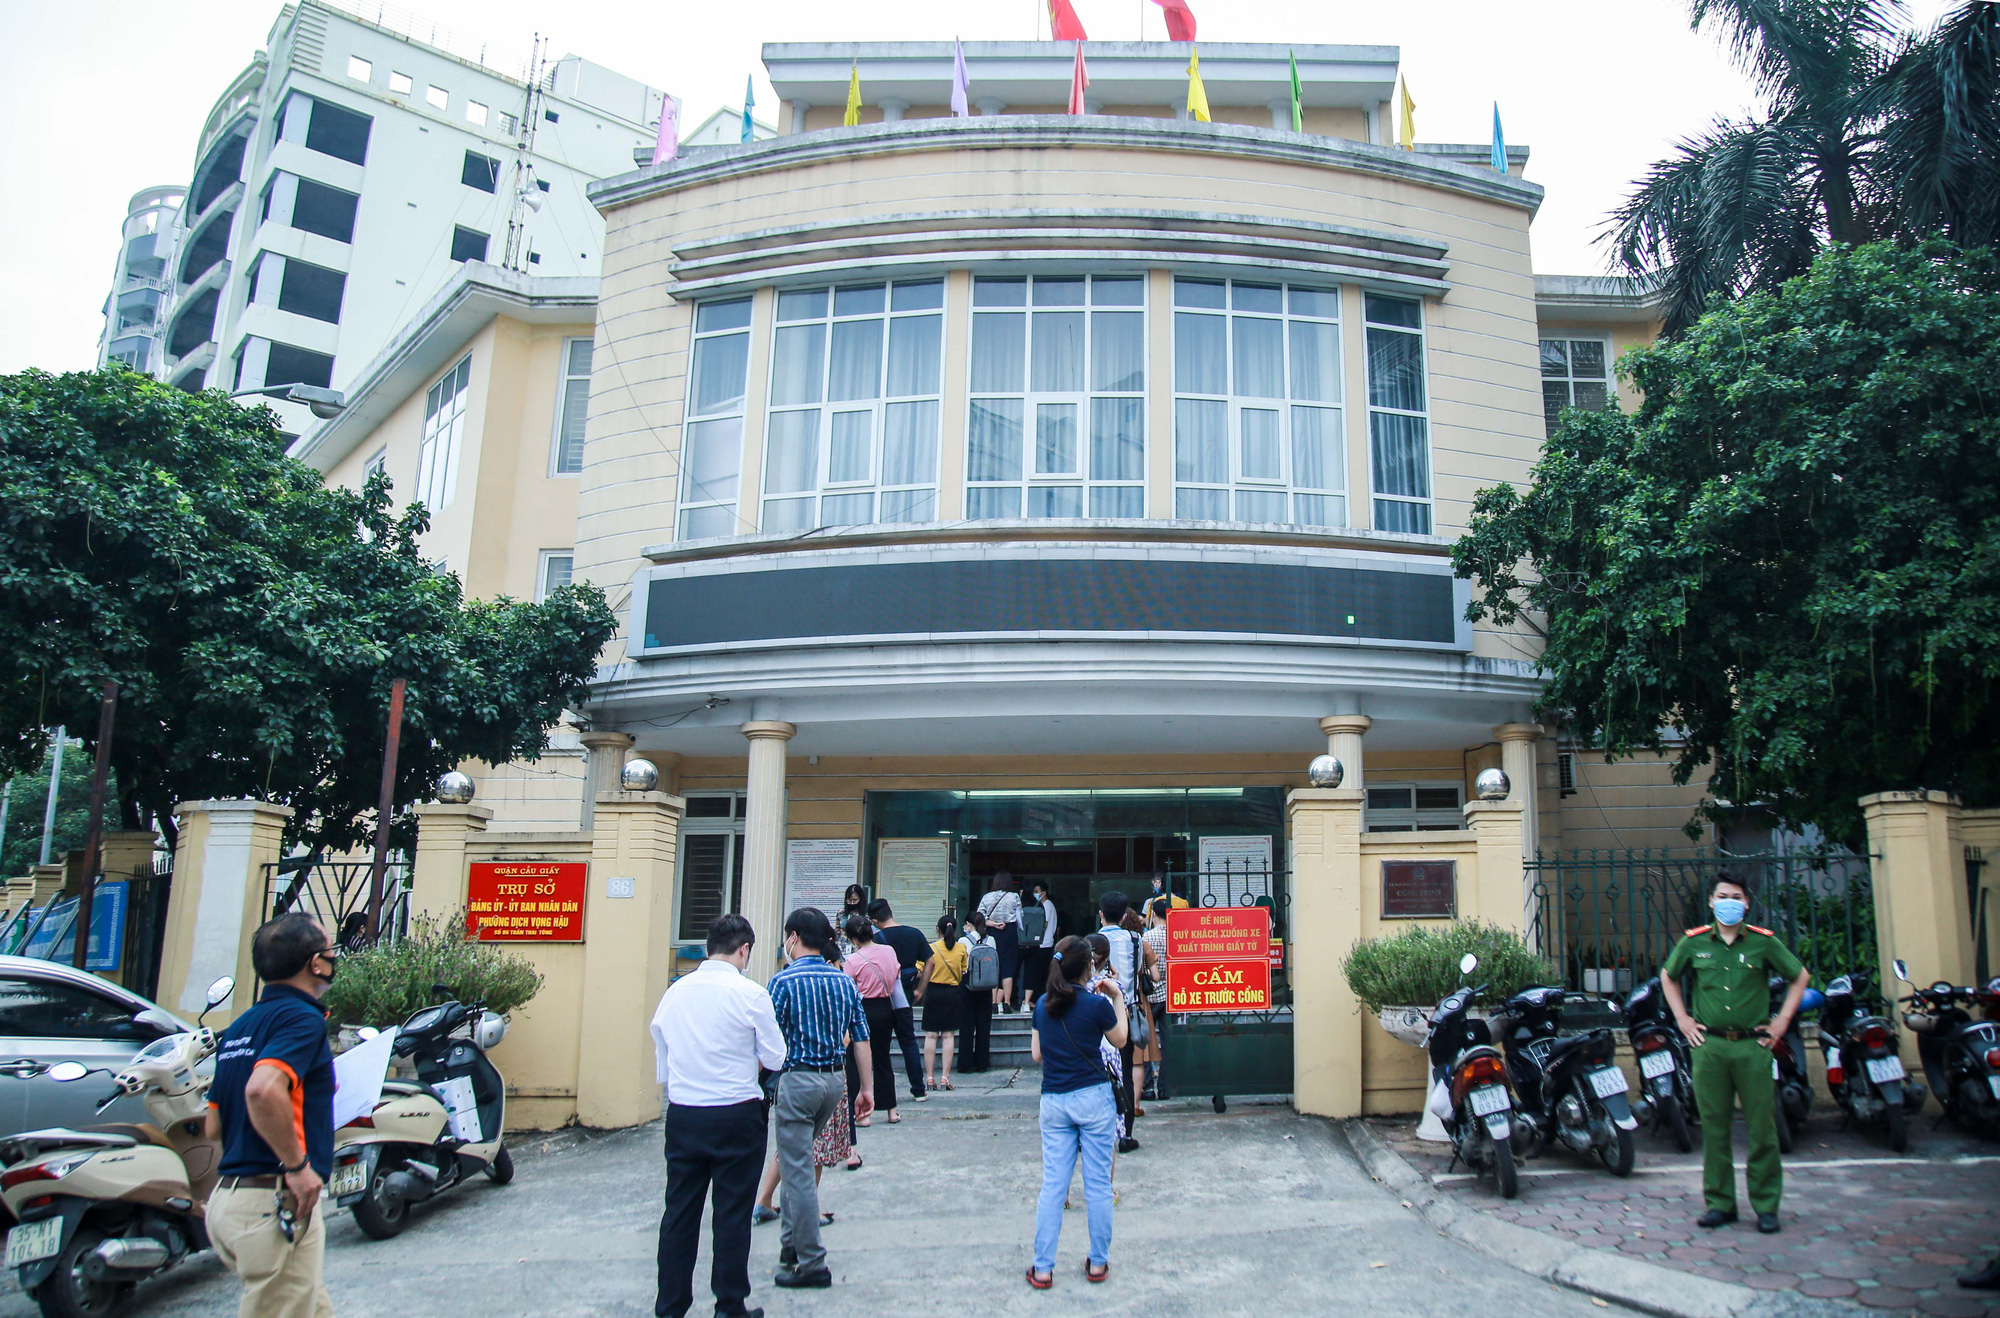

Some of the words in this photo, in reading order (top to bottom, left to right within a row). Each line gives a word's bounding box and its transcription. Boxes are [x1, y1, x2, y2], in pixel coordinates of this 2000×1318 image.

[494, 866, 518, 875] QUẬN
[539, 865, 560, 874] GIẤY
[497, 884, 528, 897] TRỤ
[534, 878, 556, 895] SỞ
[612, 880, 629, 895] 86
[471, 898, 492, 912] ĐẢNG
[493, 898, 504, 912] ỦY
[509, 898, 519, 912] ỦY
[520, 902, 536, 912] BAN
[538, 899, 560, 912] NHÂN
[562, 899, 578, 912] DÂN
[511, 917, 529, 929] DỊCH
[531, 917, 551, 929] VỌNG
[553, 915, 569, 929] HẬU
[1213, 915, 1233, 926] NGHỊ
[1173, 929, 1189, 940] QUÝ
[1191, 928, 1219, 939] KHÁCH
[1220, 926, 1248, 938] XUỐNG
[1250, 928, 1261, 938] XE
[1177, 940, 1198, 952] XUẤT
[1200, 941, 1224, 952] TRÌNH
[1226, 939, 1245, 951] GIẤY
[1246, 939, 1257, 951] TỜ
[1193, 964, 1244, 985] CẤM
[1173, 987, 1187, 1005] ĐỖ
[1189, 992, 1202, 1005] XE
[1204, 987, 1235, 1004] TRƯỚC
[1237, 985, 1264, 1003] CỔNG
[1479, 1099, 1505, 1113] 0929
[11, 1238, 56, 1263] 104.18
